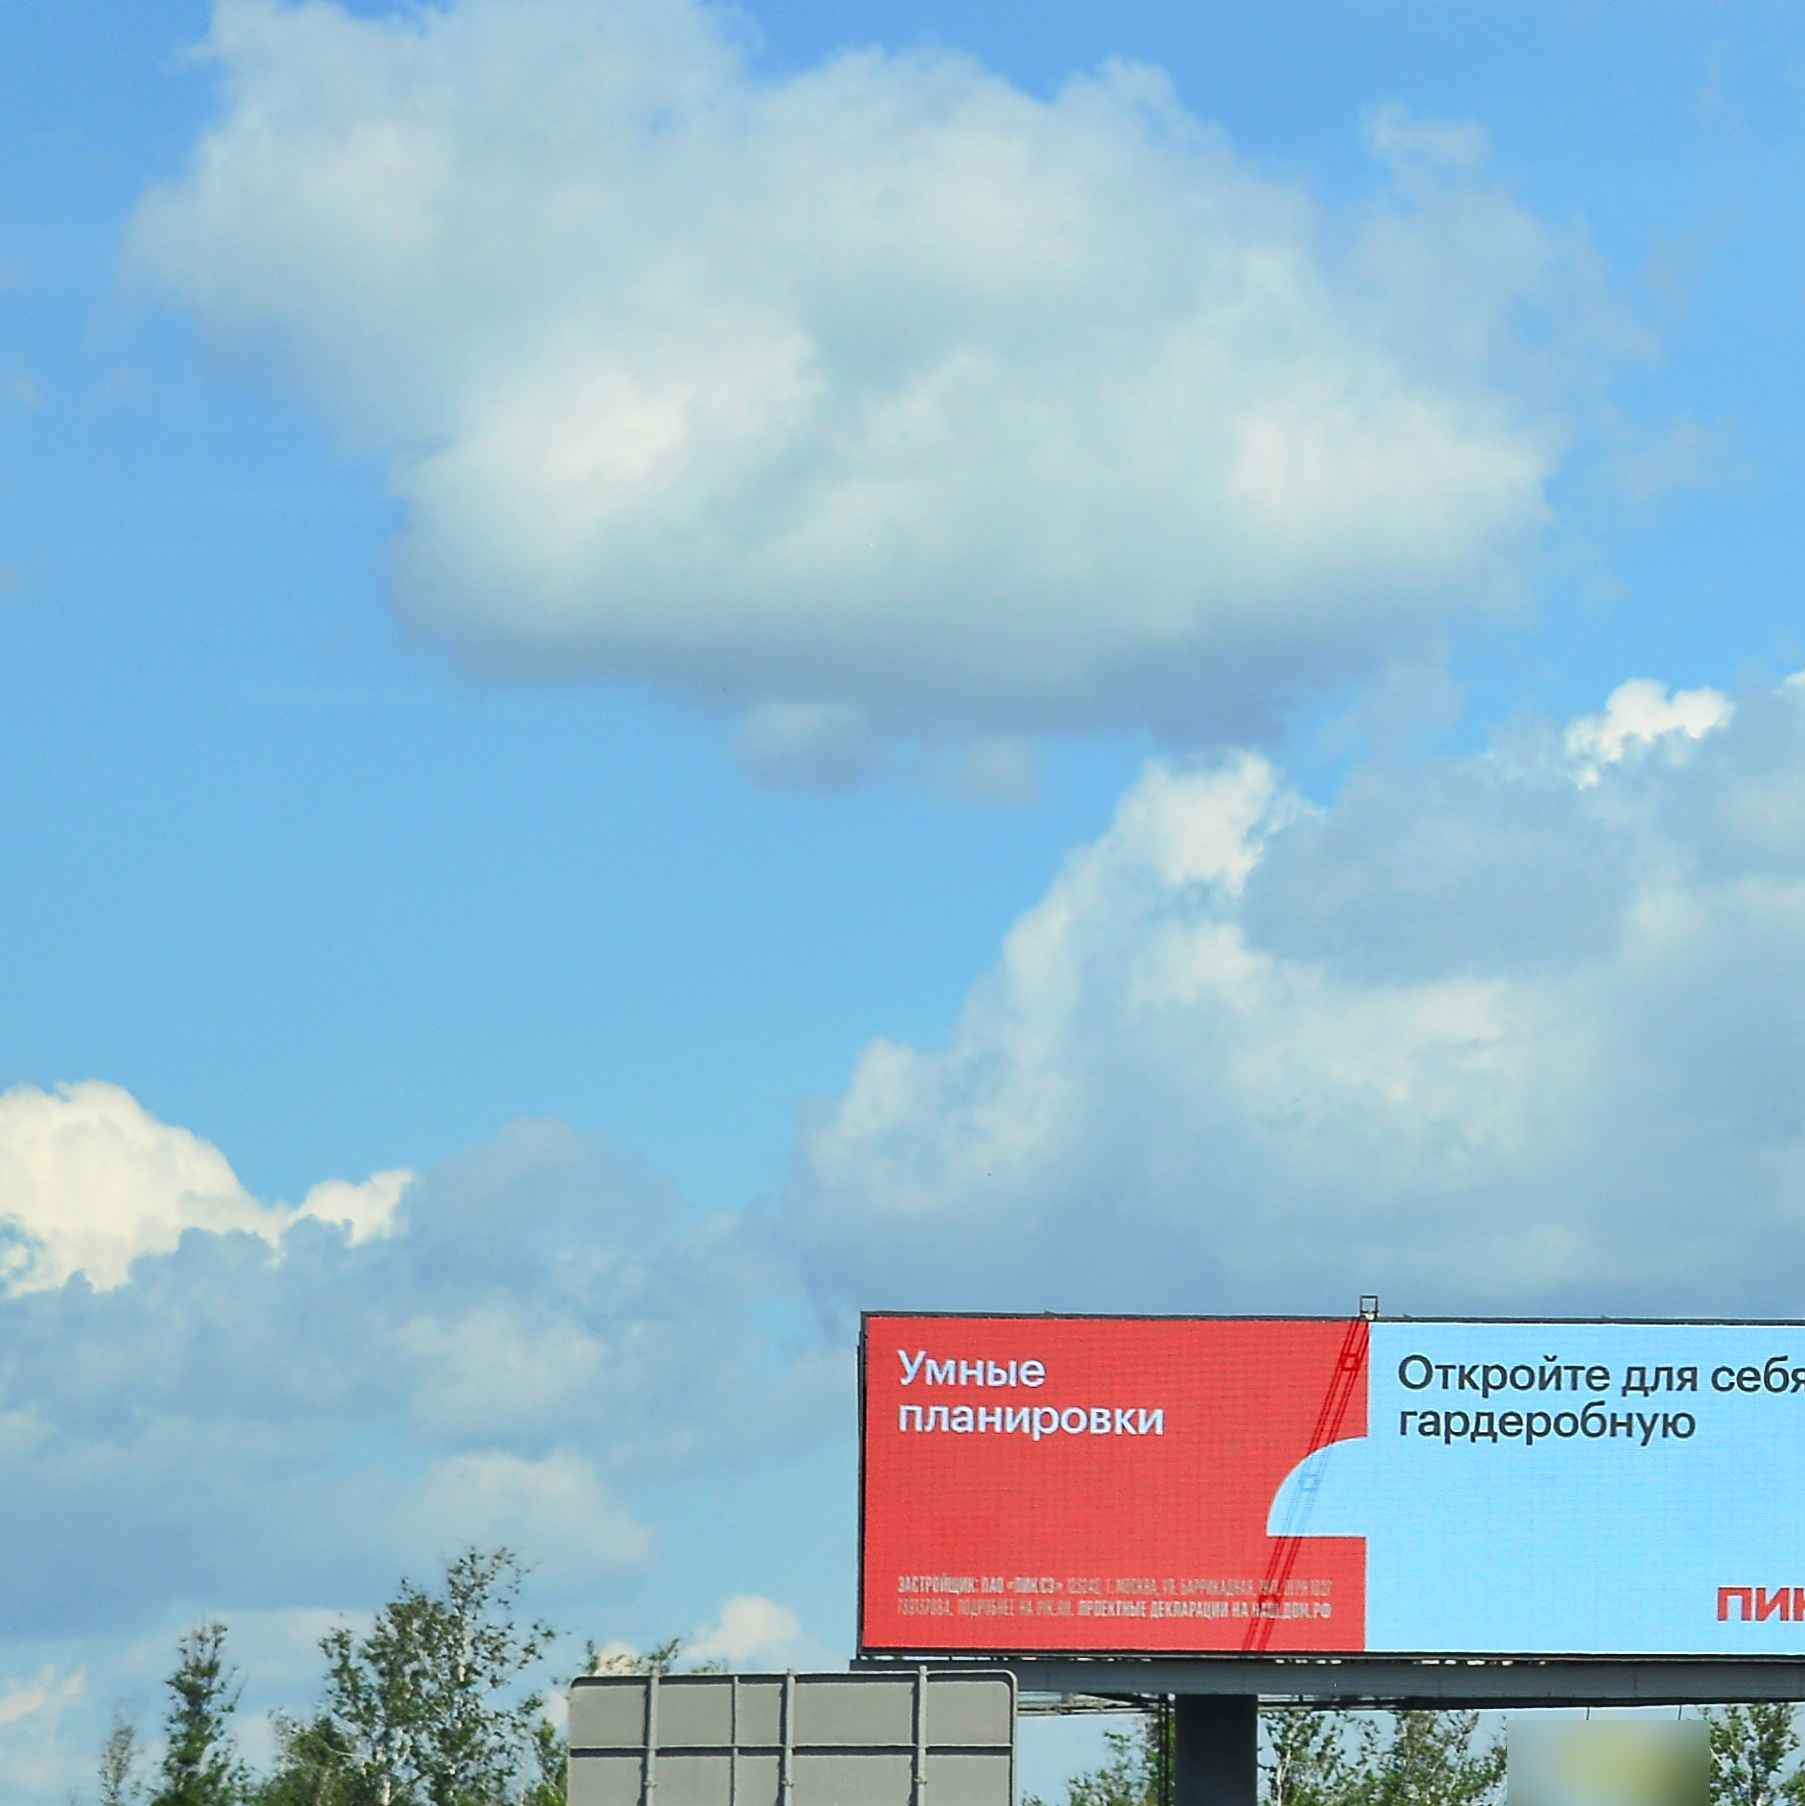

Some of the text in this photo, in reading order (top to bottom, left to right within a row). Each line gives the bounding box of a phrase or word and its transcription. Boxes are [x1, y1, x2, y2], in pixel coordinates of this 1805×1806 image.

[896, 1350, 1046, 1389] Умные
[1397, 1353, 1611, 1394] Откройте
[1621, 1360, 1698, 1395] для
[897, 1403, 1164, 1438] планировки
[1398, 1402, 1696, 1444] гардеробную
